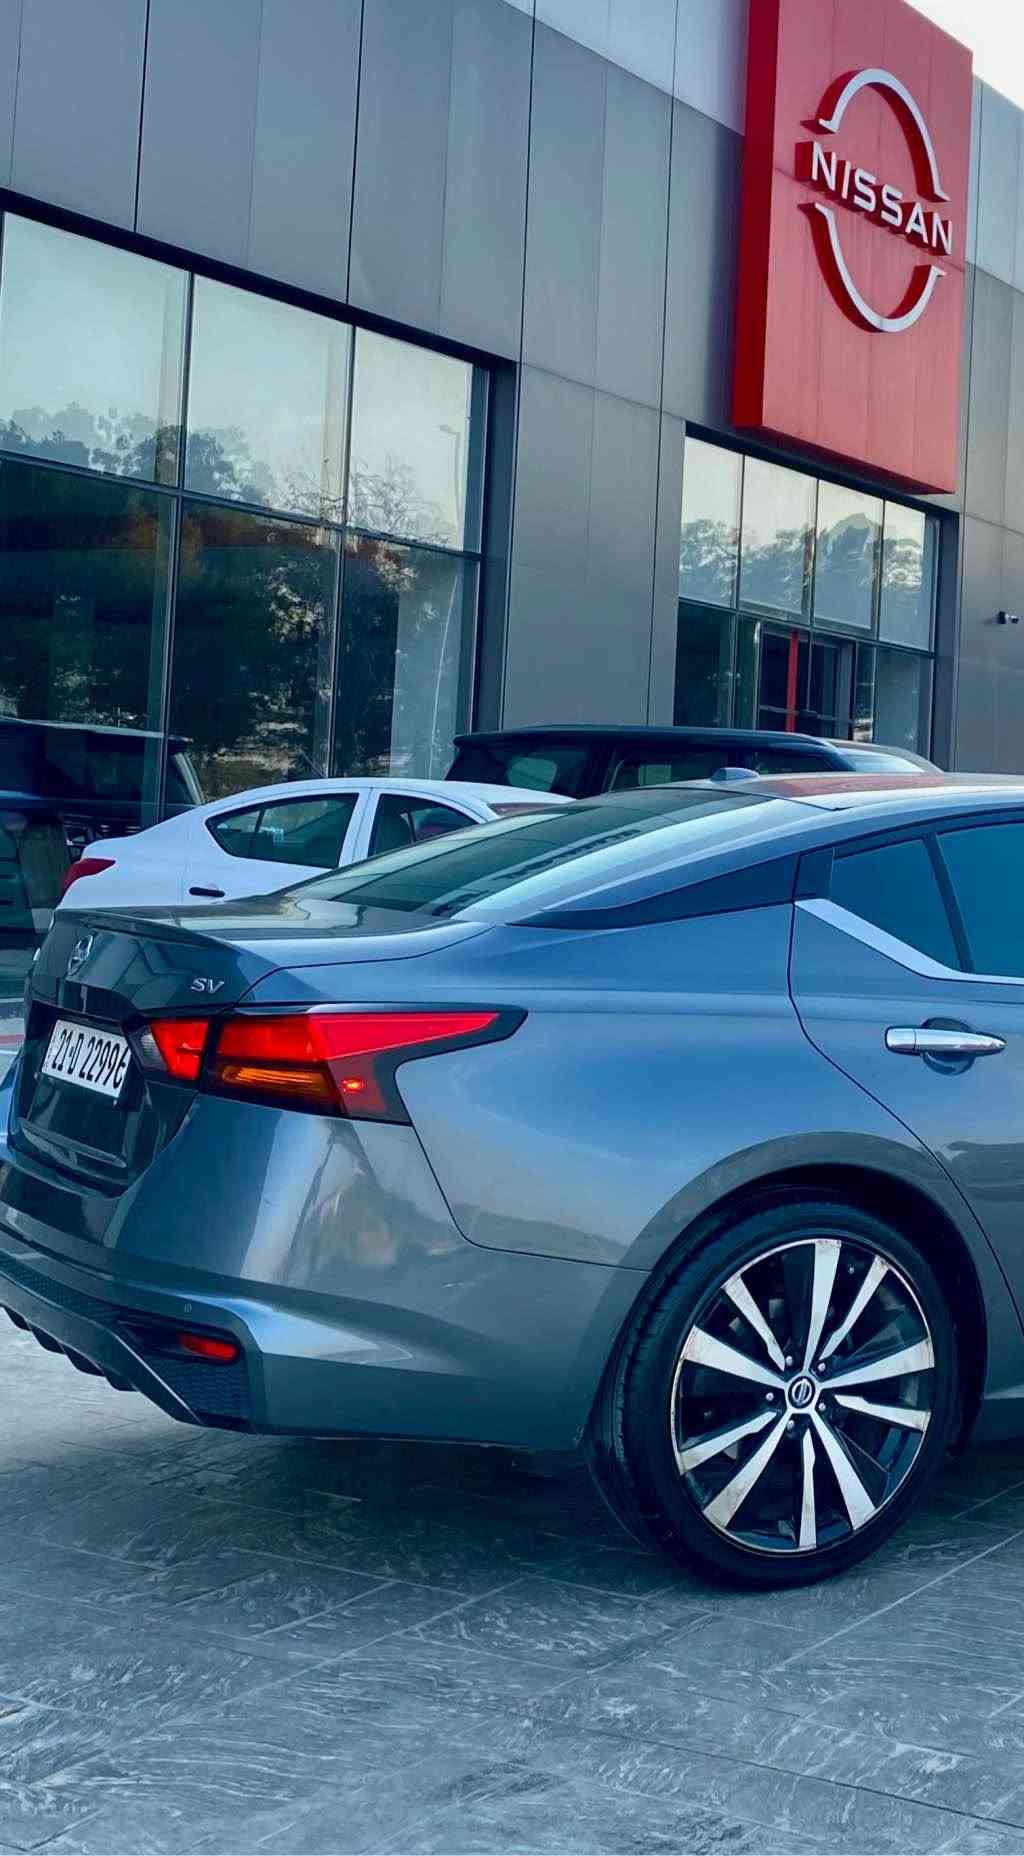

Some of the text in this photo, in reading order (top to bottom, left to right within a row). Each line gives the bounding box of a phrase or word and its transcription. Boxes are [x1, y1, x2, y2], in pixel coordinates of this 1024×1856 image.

[811, 140, 953, 256] NISSAN
[190, 977, 225, 994] SV
[52, 1029, 73, 1072] 21
